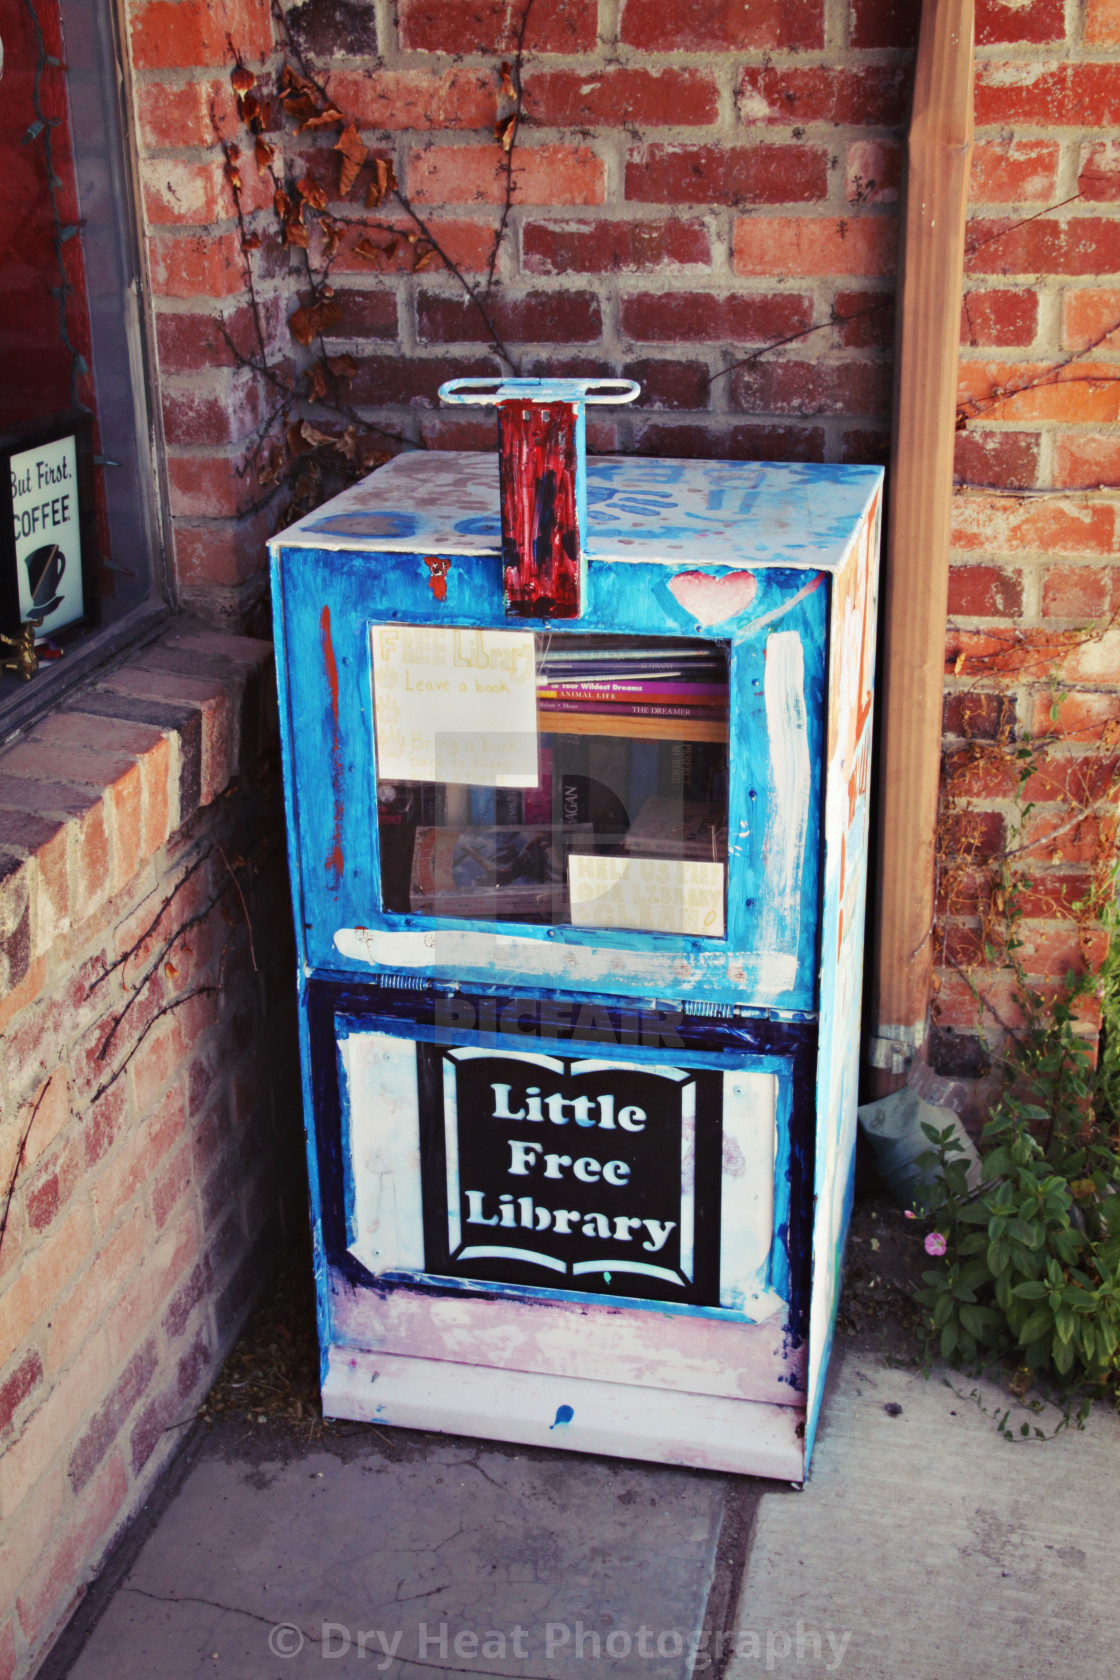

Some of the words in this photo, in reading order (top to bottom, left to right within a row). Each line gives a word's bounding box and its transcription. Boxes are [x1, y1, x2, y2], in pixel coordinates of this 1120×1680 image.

[10, 469, 33, 498] But
[36, 456, 72, 490] First,
[14, 494, 71, 541] COFFEE
[379, 629, 447, 666] FREE
[453, 629, 533, 683] Library
[405, 670, 449, 692] Leave
[459, 683, 469, 692] a
[475, 678, 511, 693] book
[560, 691, 593, 699] ANIMAL
[597, 692, 617, 700] LIFE
[580, 683, 610, 691] Wildest
[632, 706, 649, 714] THE
[651, 707, 691, 716] DREAMER
[411, 730, 458, 756] Bring
[577, 858, 631, 880] HELP
[640, 862, 670, 883] US
[676, 862, 720, 886] KEEP
[577, 883, 624, 903] OUR
[633, 885, 722, 908] LIBRARY
[490, 1083, 648, 1132] Little
[507, 1139, 631, 1186] Free
[464, 1190, 677, 1252] Library
